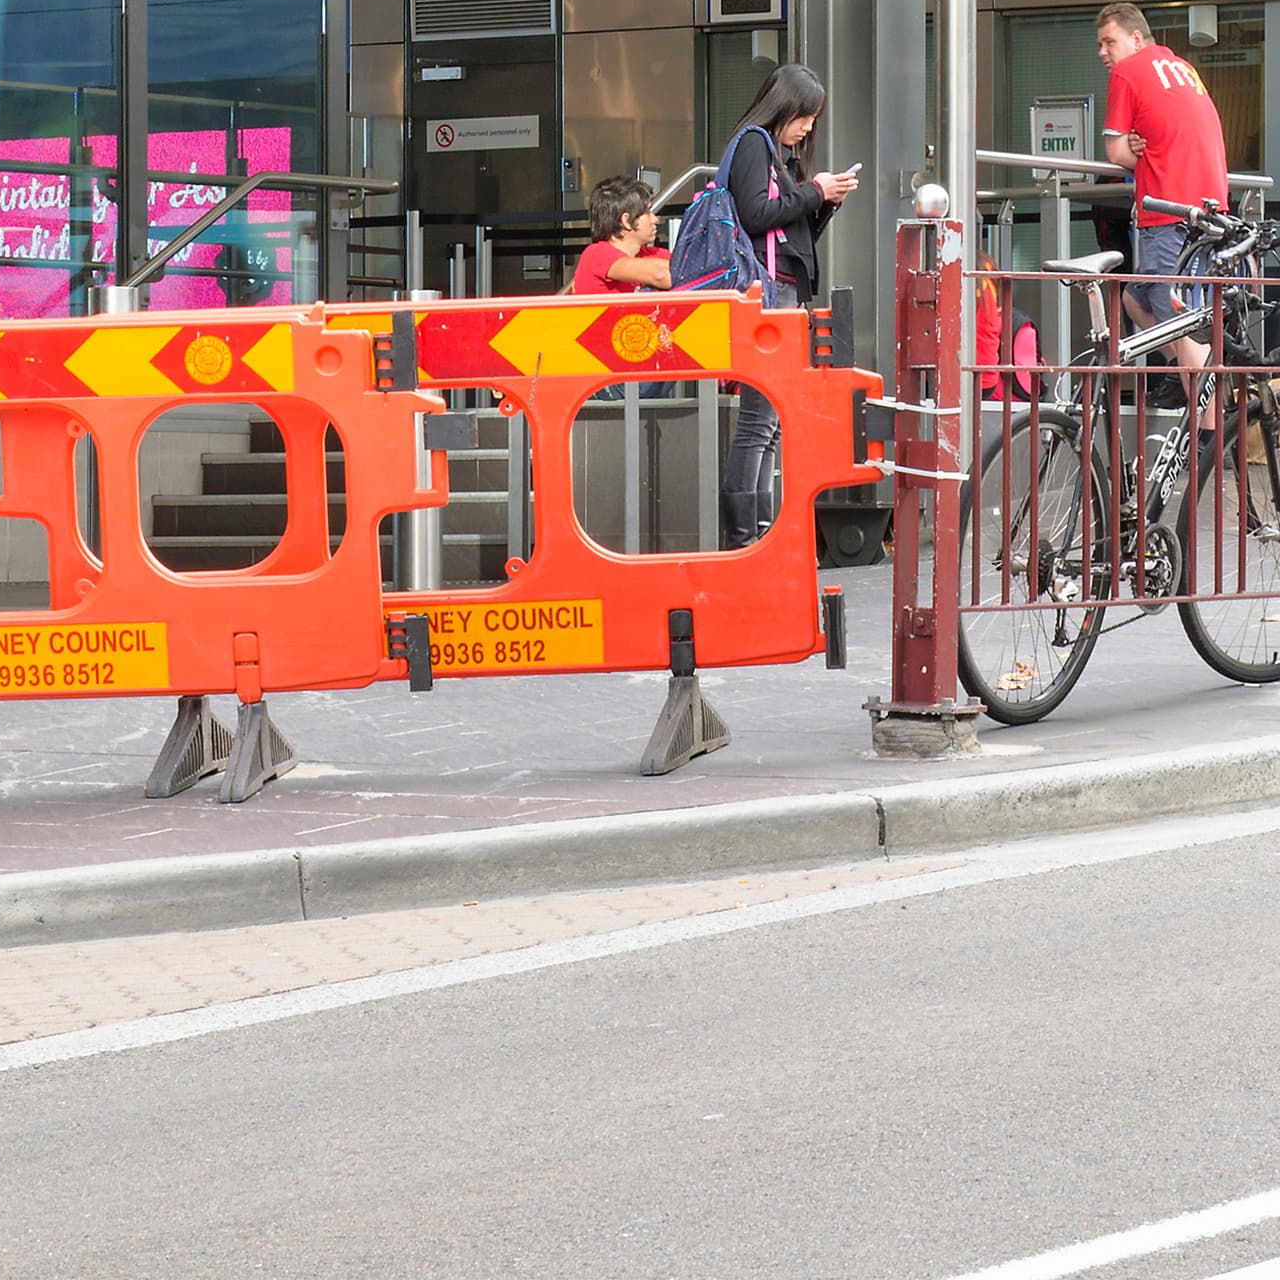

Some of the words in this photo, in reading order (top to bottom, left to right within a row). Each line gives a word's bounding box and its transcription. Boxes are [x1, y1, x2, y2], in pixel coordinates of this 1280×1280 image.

[1041, 136, 1076, 152] ENTRY
[428, 610, 472, 634] NEY
[484, 606, 593, 632] COUNCIL
[49, 629, 155, 654] COUNCIL
[431, 641, 484, 666] 9936
[495, 639, 546, 663] 8512
[0, 664, 56, 688] 9936
[63, 662, 115, 685] 8512
